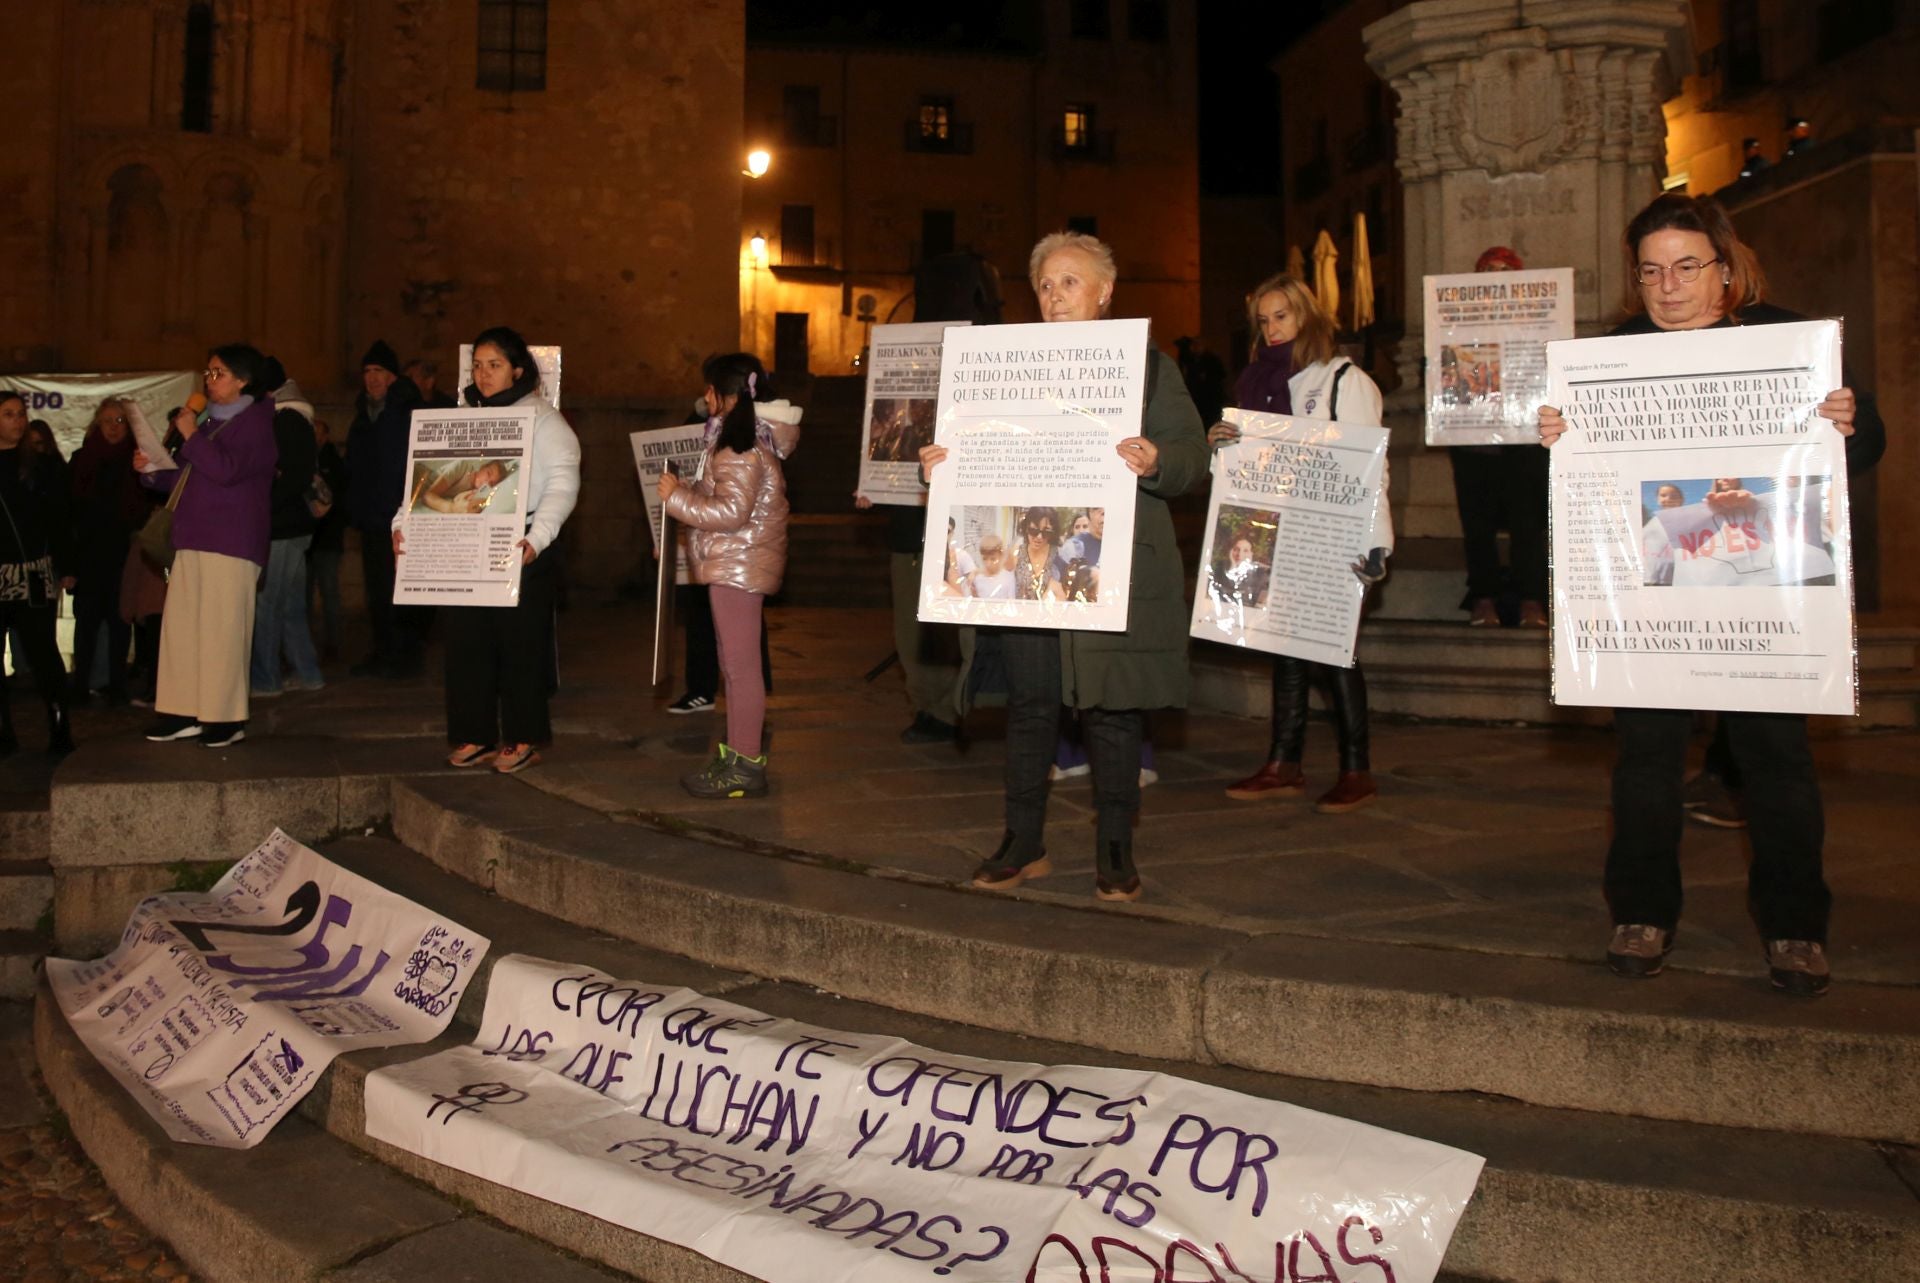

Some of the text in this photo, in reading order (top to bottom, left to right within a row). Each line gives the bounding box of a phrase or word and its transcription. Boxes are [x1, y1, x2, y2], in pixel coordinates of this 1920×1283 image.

[876, 346, 927, 358] BREAKING
[959, 347, 1126, 365] JUANA RIVAS ENTREGA A
[952, 370, 970, 383] SU
[972, 369, 1001, 382] HIJO
[1003, 368, 1053, 382] DANIEL
[1056, 367, 1075, 380] AL
[953, 385, 1126, 404] QUE SE LO LLEVA A ITALIA
[1574, 374, 1813, 402] LA JUSTICIA NAVARRA REBAJA L
[20, 391, 64, 410] EDO
[1633, 400, 1641, 412] A
[1642, 399, 1663, 412] UN
[1666, 395, 1730, 411] HOMBRE
[1734, 394, 1762, 409] QUE
[1593, 414, 1644, 429] MENOR
[1648, 413, 1665, 426] DE
[1670, 412, 1685, 425] 13
[1690, 408, 1729, 424] AÑOS
[1731, 408, 1740, 421] Y
[1585, 427, 1676, 444] APARENTABA
[1681, 424, 1728, 440] TENER
[1767, 421, 1788, 435] DE
[1792, 420, 1809, 434] 16
[980, 439, 1019, 447] granadina
[1271, 442, 1334, 460] NEVENKA
[1226, 468, 1371, 499] SOCIEDAD FUE EL QUE
[1262, 463, 1321, 480] SILENCIO
[1323, 471, 1341, 483] DE
[1344, 474, 1361, 486] LA
[1302, 489, 1322, 501] ME
[1678, 528, 1717, 561] NO
[1577, 616, 1800, 635] AQUELLA NOCHE, LA VÍCTIMA,
[1623, 637, 1637, 650] 13
[1642, 633, 1683, 651] AÑOS
[1684, 638, 1692, 651] Y
[1697, 638, 1713, 651] 10
[1716, 638, 1772, 652] MESES!
[200, 984, 248, 1035] MACHISTA
[559, 1041, 632, 1095] QUE
[640, 1052, 820, 1156] LUCHAN
[847, 1108, 890, 1160] Y
[892, 1122, 967, 1171] NO
[979, 1143, 1055, 1185] POR
[1067, 1156, 1163, 1227] LAS
[774, 1034, 860, 1080] TE
[867, 1055, 1149, 1148] OFENDES
[1149, 1113, 1280, 1217] POR
